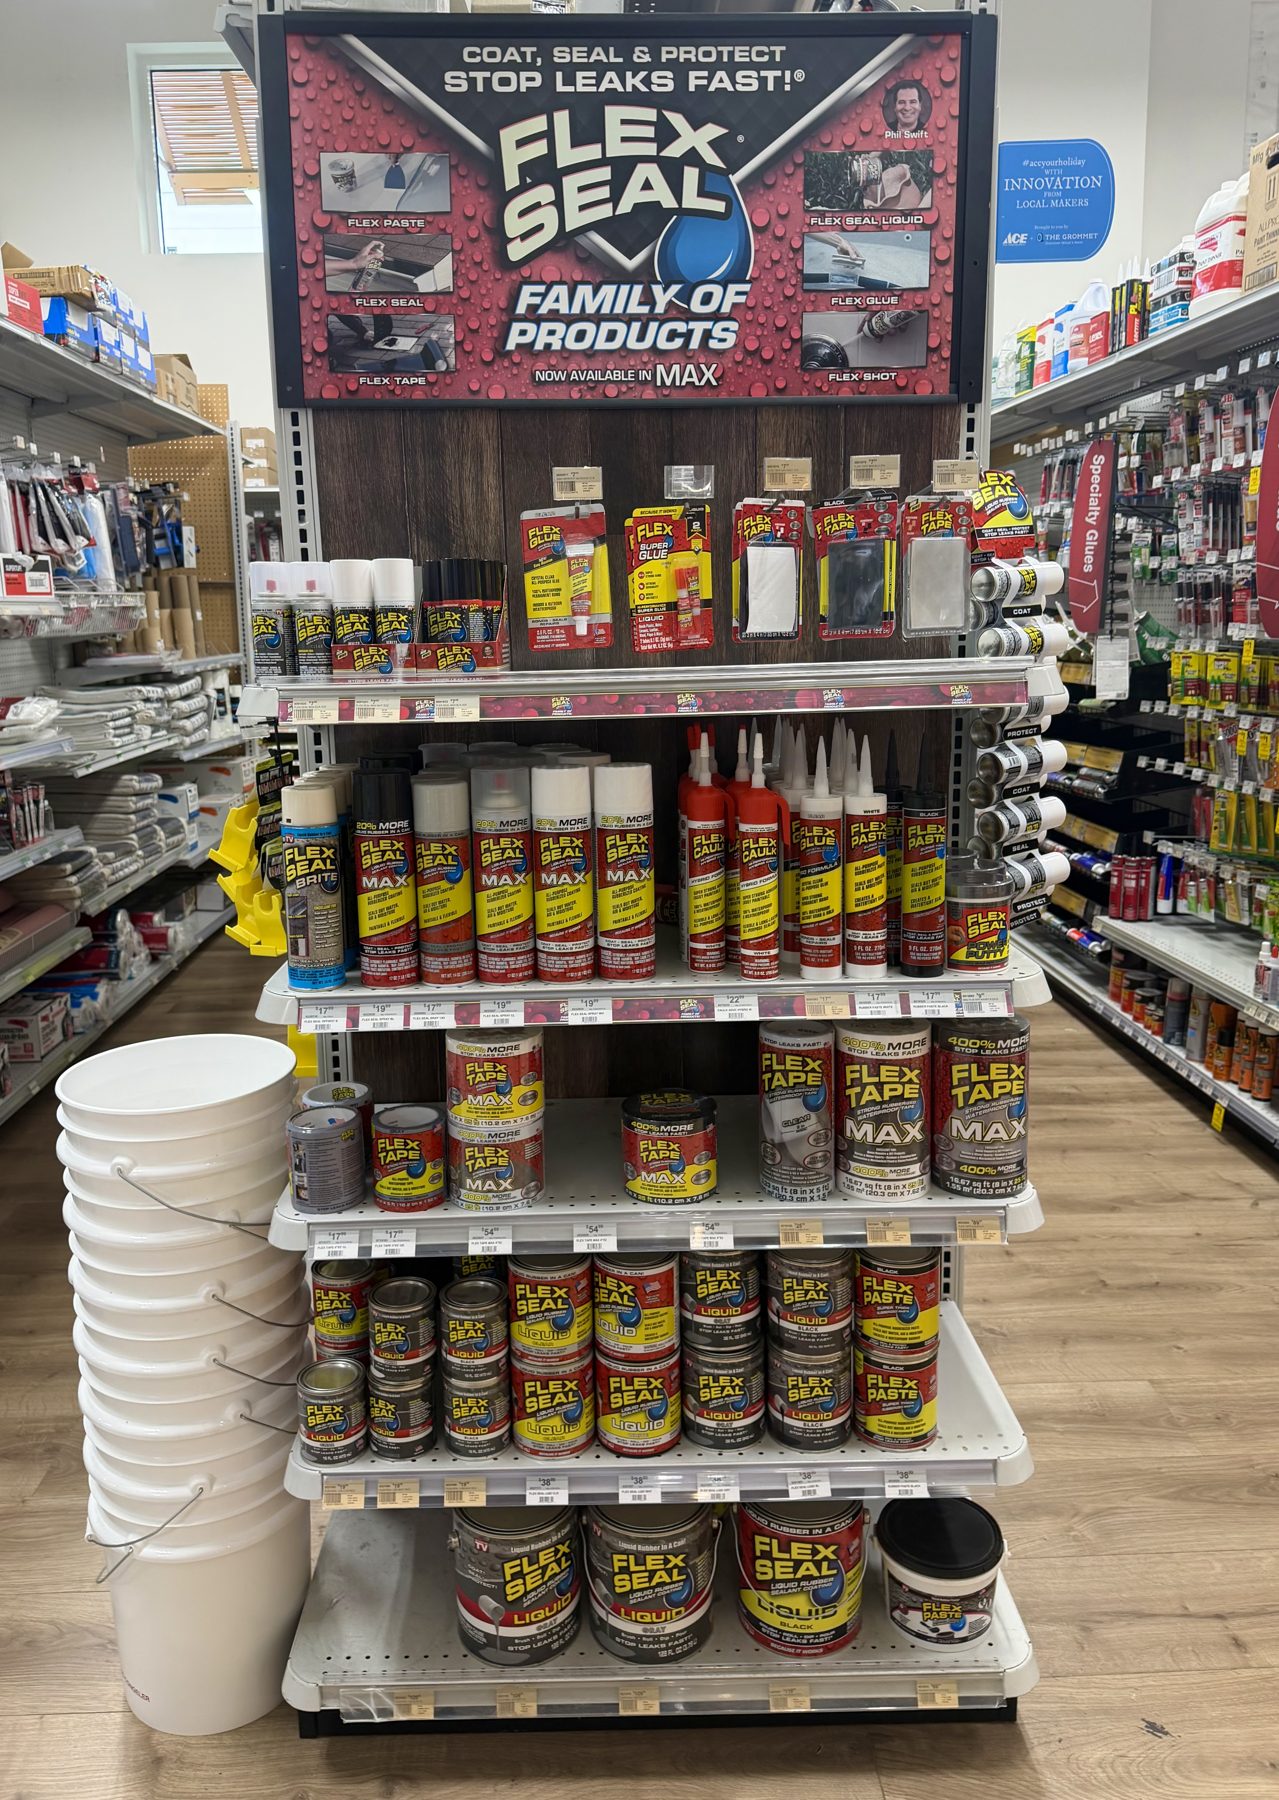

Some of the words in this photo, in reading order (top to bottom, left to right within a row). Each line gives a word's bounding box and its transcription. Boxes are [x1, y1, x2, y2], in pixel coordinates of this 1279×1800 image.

[462, 46, 542, 66] COAT,
[552, 46, 623, 63] SEAL
[633, 46, 652, 63] &
[661, 46, 786, 62] PROTECT
[443, 71, 542, 93] STOP
[555, 70, 675, 93] LEAKS
[884, 130, 900, 140] Phil
[904, 130, 929, 140] Swift
[499, 105, 729, 191] FLEX
[1004, 176, 1103, 191] INNOVATION
[1016, 200, 1048, 209] LOCAL
[1050, 199, 1089, 208] MAKERS
[503, 162, 727, 262] SEAL
[347, 218, 379, 228] FLEX
[383, 218, 425, 228] PASTE
[810, 216, 842, 226] FLEX
[845, 216, 878, 226] SEAL
[881, 215, 923, 226] LIQUID
[1003, 232, 1028, 244] ACE
[355, 298, 387, 307] FLEX
[391, 298, 424, 307] SEAL
[515, 283, 683, 314] FAMILY
[690, 283, 753, 313] OF
[831, 296, 863, 306] FLEX
[866, 296, 899, 306] GLUE
[505, 320, 739, 352] PRODUCTS
[359, 376, 391, 386] FLEX
[395, 376, 426, 386] TAPE
[535, 369, 567, 382] NOW
[569, 369, 636, 382] AVAILABLE
[638, 369, 652, 382] IN
[655, 363, 718, 387] MAX
[828, 372, 860, 382] FLEX
[863, 372, 897, 382] SHOT
[1083, 454, 1105, 526] Specialty
[972, 486, 1019, 512] SEAL
[743, 514, 772, 528] FLEX
[823, 513, 855, 527] FLEX
[528, 525, 561, 539] FLEX
[637, 522, 673, 542] FLEX
[743, 523, 772, 538] TAPE
[824, 522, 855, 536] TAPE
[529, 534, 561, 549] GLUE
[639, 543, 669, 551] SUPER
[638, 549, 668, 560] GLUE
[1083, 529, 1099, 574] Glues
[335, 612, 369, 625] FLEX
[336, 622, 370, 638] SEAL
[353, 646, 389, 660] FLEX
[354, 655, 389, 671] SEAL
[1007, 727, 1038, 737] PROTECT
[356, 821, 377, 830] 20%
[378, 820, 409, 830] MORE
[499, 818, 528, 826] MORE
[907, 824, 945, 838] FLEX
[360, 840, 404, 857] FLEX
[480, 838, 524, 854] FLEX
[605, 833, 649, 851] FLEX
[742, 838, 776, 854] FLEX
[908, 834, 946, 850] PASTE
[285, 845, 335, 865] FLEX
[361, 852, 405, 870] SEAL
[481, 848, 524, 866] SEAL
[606, 845, 649, 864] SEAL
[742, 847, 777, 864] CAULK
[285, 861, 336, 882] SEAL
[607, 869, 651, 882] MAX
[295, 873, 338, 889] BRITE
[362, 875, 409, 889] MAX
[481, 873, 527, 886] MAX
[1016, 897, 1047, 912] PROTECT
[967, 911, 1006, 928] FLEX
[967, 922, 1006, 938] SEAL
[841, 1035, 886, 1051] 400%
[887, 1036, 928, 1051] MORE
[465, 1061, 507, 1074] FLEX
[762, 1053, 822, 1073] FLEX
[466, 1071, 507, 1086] TAPE
[763, 1072, 823, 1091] TAPE
[845, 1064, 921, 1086] FLEX
[951, 1063, 1026, 1086] FLEX
[466, 1093, 513, 1106] MAX
[845, 1084, 920, 1109] TAPE
[952, 1080, 1026, 1109] TAPE
[630, 1120, 660, 1132] 400%
[660, 1123, 694, 1133] MORE
[781, 1114, 812, 1128] CLEAR
[844, 1116, 925, 1145] MAX
[951, 1117, 1027, 1145] MAX
[377, 1138, 421, 1152] FLEX
[640, 1140, 680, 1152] FLEX
[378, 1149, 420, 1167] TAPE
[640, 1150, 681, 1162] TAPE
[640, 1171, 685, 1184] MAX
[876, 1266, 899, 1275] BLACK
[783, 1278, 829, 1291] FLEX
[862, 1276, 914, 1294] FLEX
[783, 1290, 830, 1305] SEAL
[864, 1293, 914, 1306] PASTE
[787, 1313, 828, 1325] LIQUID
[797, 1325, 819, 1333] BLACK
[609, 1376, 664, 1392] FLEX
[609, 1388, 665, 1408] SEAL
[306, 1405, 344, 1417] FLEX
[307, 1413, 344, 1428] SEAL
[611, 1418, 666, 1431] LIQUID
[311, 1433, 345, 1442] LIQUID
[618, 1540, 636, 1551] Liquid
[637, 1541, 660, 1551] Rubber
[754, 1534, 838, 1560] FLEX
[502, 1539, 573, 1582] FLEX
[612, 1553, 686, 1572] FLEX
[755, 1560, 838, 1582] SEAL
[504, 1556, 573, 1603] SEAL
[613, 1570, 687, 1593] SEAL
[770, 1582, 798, 1590] LIQUID
[799, 1577, 835, 1588] RUBBER
[513, 1593, 572, 1625] LIQUID
[620, 1607, 686, 1623] LIQUID
[757, 1598, 838, 1622] LIQUID
[922, 1603, 963, 1613] FLEX
[923, 1610, 963, 1621] PASTE
[779, 1620, 814, 1631] BLACK
[615, 1637, 637, 1646] STOP
[638, 1642, 665, 1650] LEAKS
